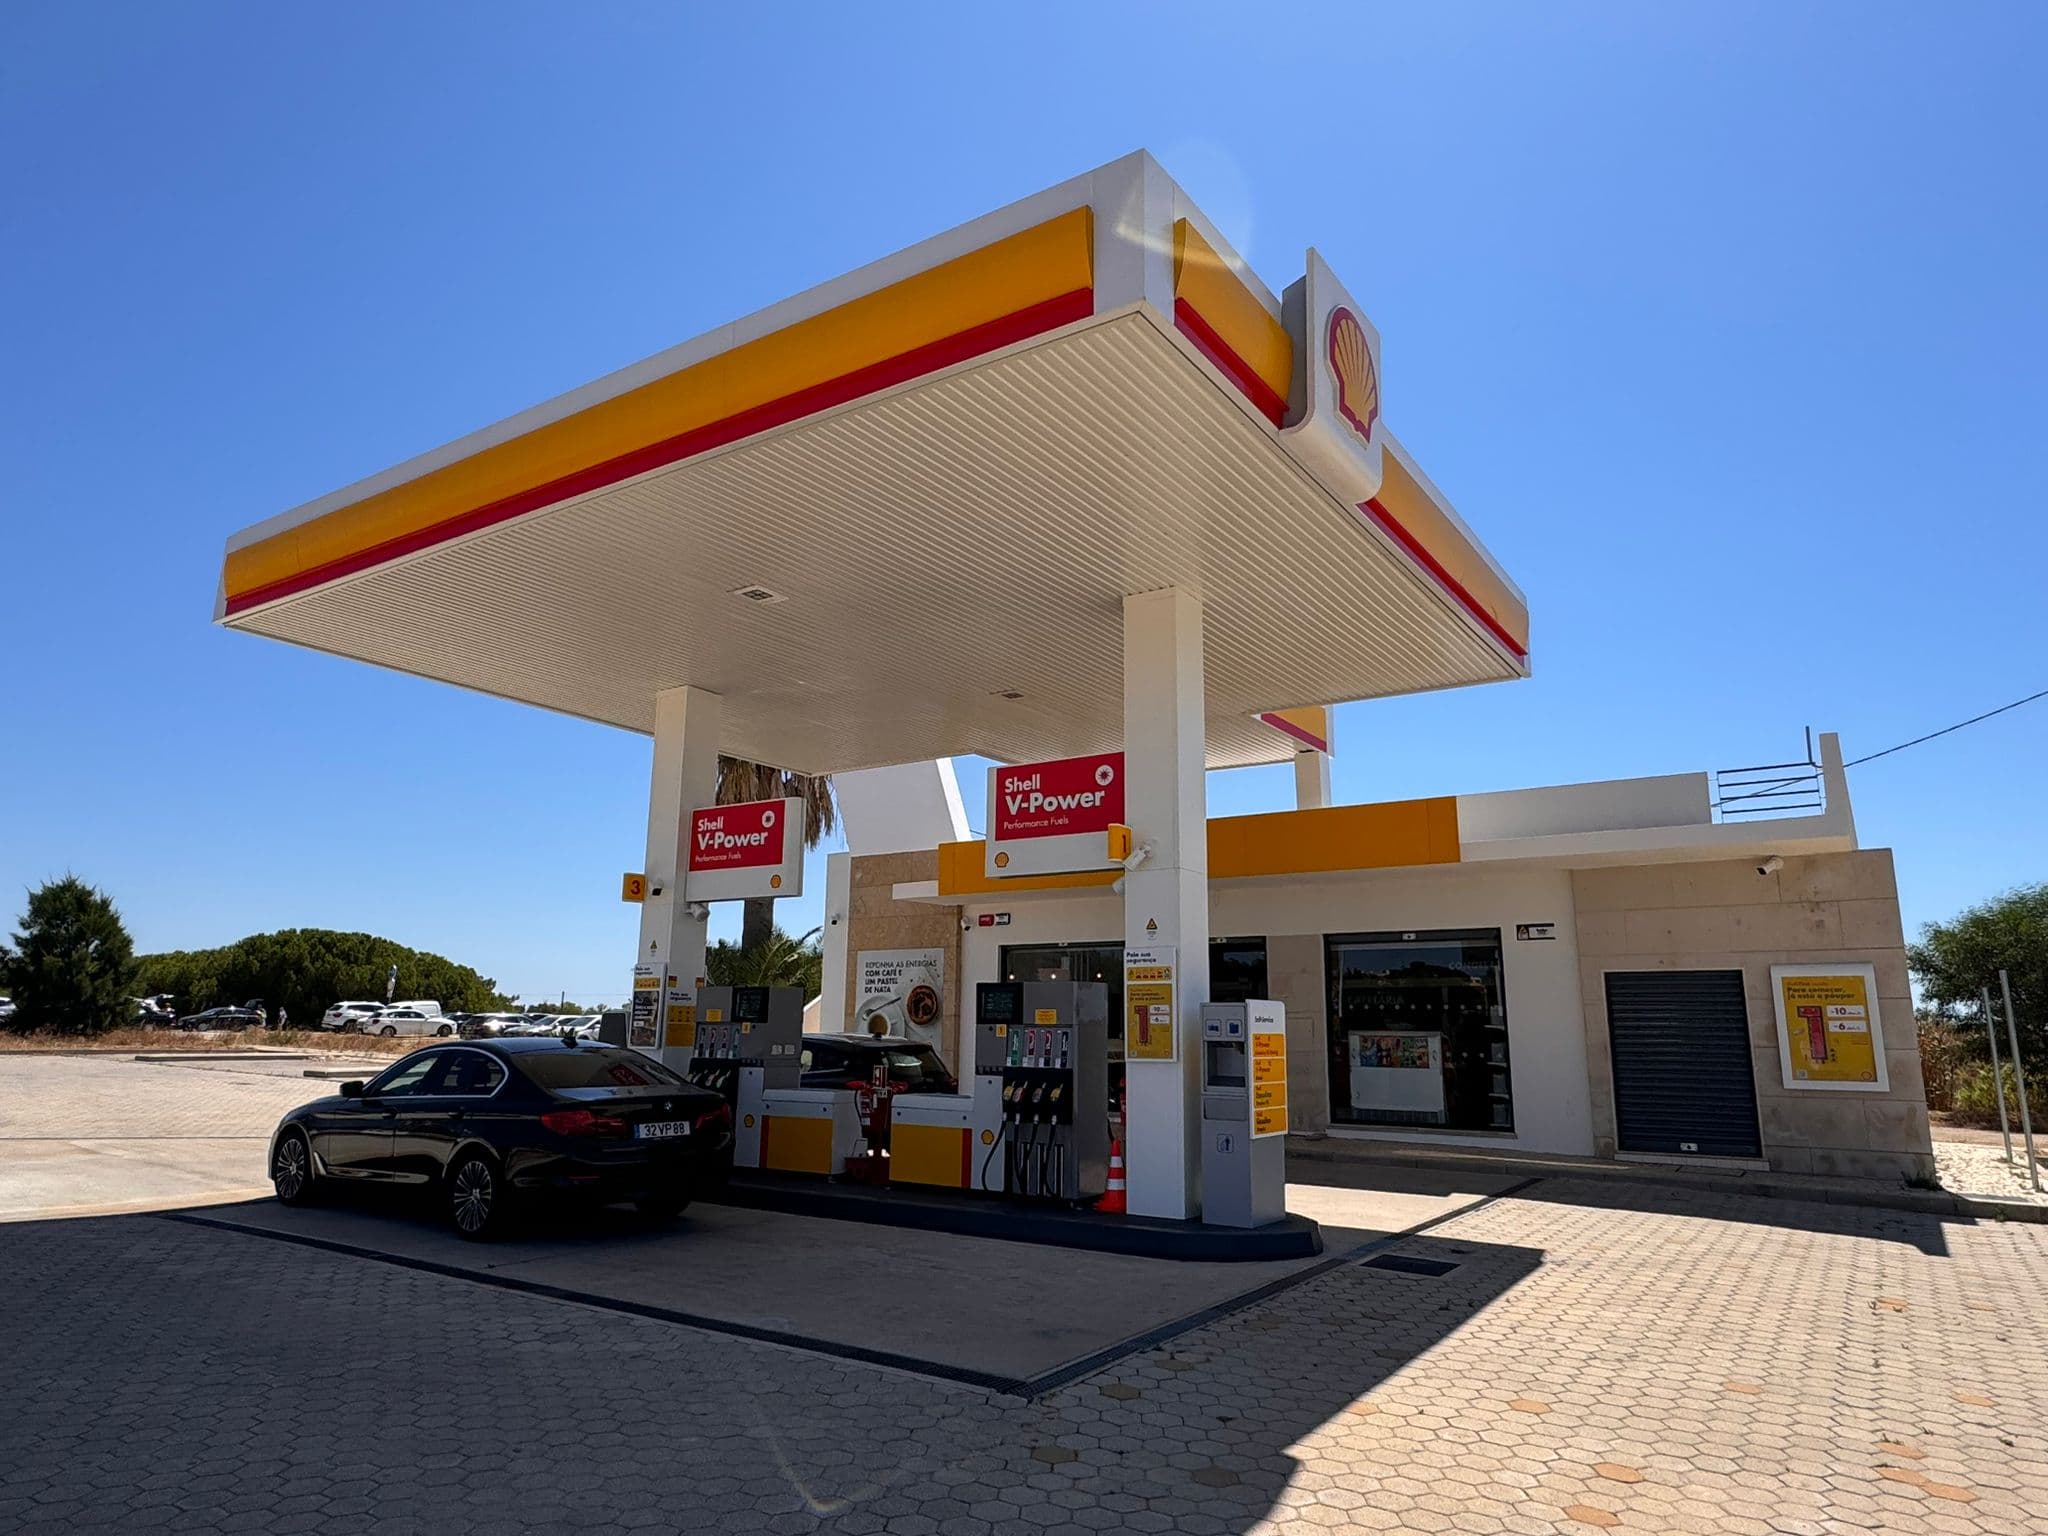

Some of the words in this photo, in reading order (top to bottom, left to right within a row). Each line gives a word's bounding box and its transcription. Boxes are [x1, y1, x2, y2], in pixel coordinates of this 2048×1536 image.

[1004, 773, 1041, 793] Shell
[1004, 789, 1105, 816] V-Power
[697, 815, 724, 832] Shell
[1003, 818, 1048, 831] Performance
[1050, 815, 1069, 827] Fuels
[697, 831, 769, 850] V-Power
[1121, 834, 1127, 853] 1
[695, 853, 727, 863] Performance
[728, 851, 742, 861] Fuels
[630, 880, 641, 895] 3
[873, 985, 891, 993] NATA
[877, 977, 898, 985] PASTEL
